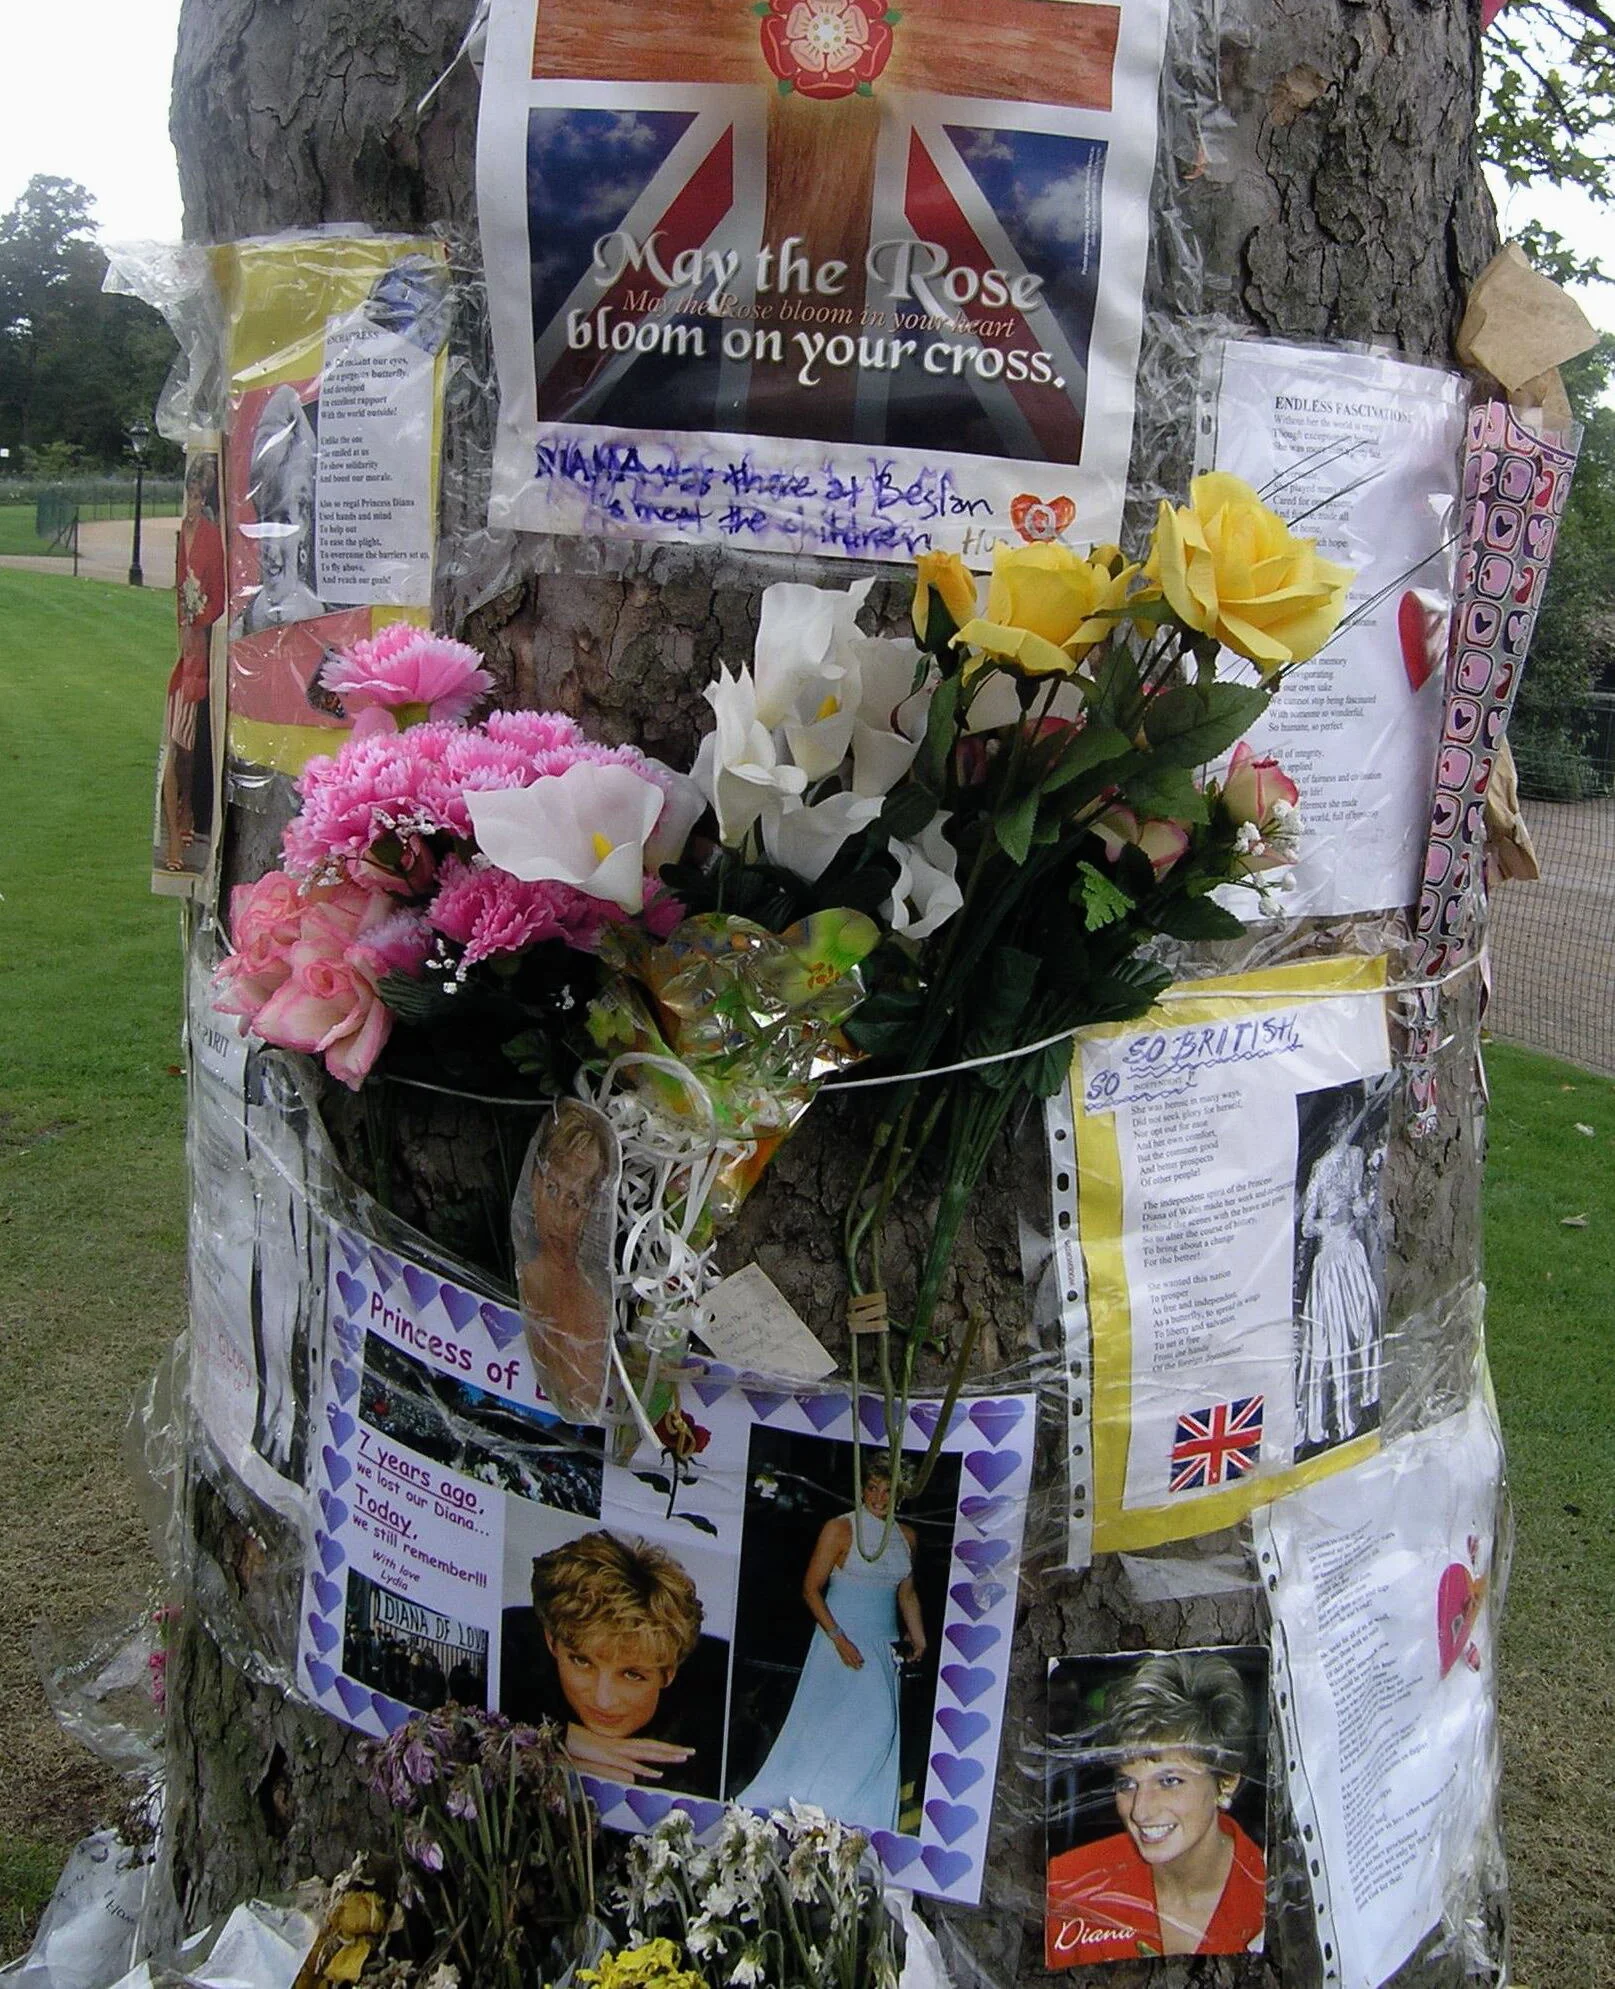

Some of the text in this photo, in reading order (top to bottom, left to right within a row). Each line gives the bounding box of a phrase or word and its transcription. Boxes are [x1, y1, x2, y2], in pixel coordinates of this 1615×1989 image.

[593, 230, 1045, 324] May the Rose
[623, 290, 670, 317] May
[675, 293, 708, 316] the
[718, 293, 772, 320] Rose
[778, 300, 853, 326] bloom
[860, 307, 885, 325] in
[567, 306, 1066, 388] bloom on your cross.
[1275, 396, 1333, 413] ENDLESS
[1122, 1034, 1166, 1064] SO
[1087, 1069, 1120, 1100] SO
[369, 1291, 520, 1389] Princess of
[359, 1429, 485, 1514] 7 years ago,
[356, 1461, 490, 1536] we lost our Diana...
[356, 1483, 418, 1540] Today,
[352, 1514, 368, 1531] we
[373, 1522, 398, 1548] still
[372, 1549, 420, 1582] With love
[380, 1569, 408, 1591] Lydia
[385, 1595, 428, 1635] DIANA
[1054, 1917, 1136, 1950] Diana
